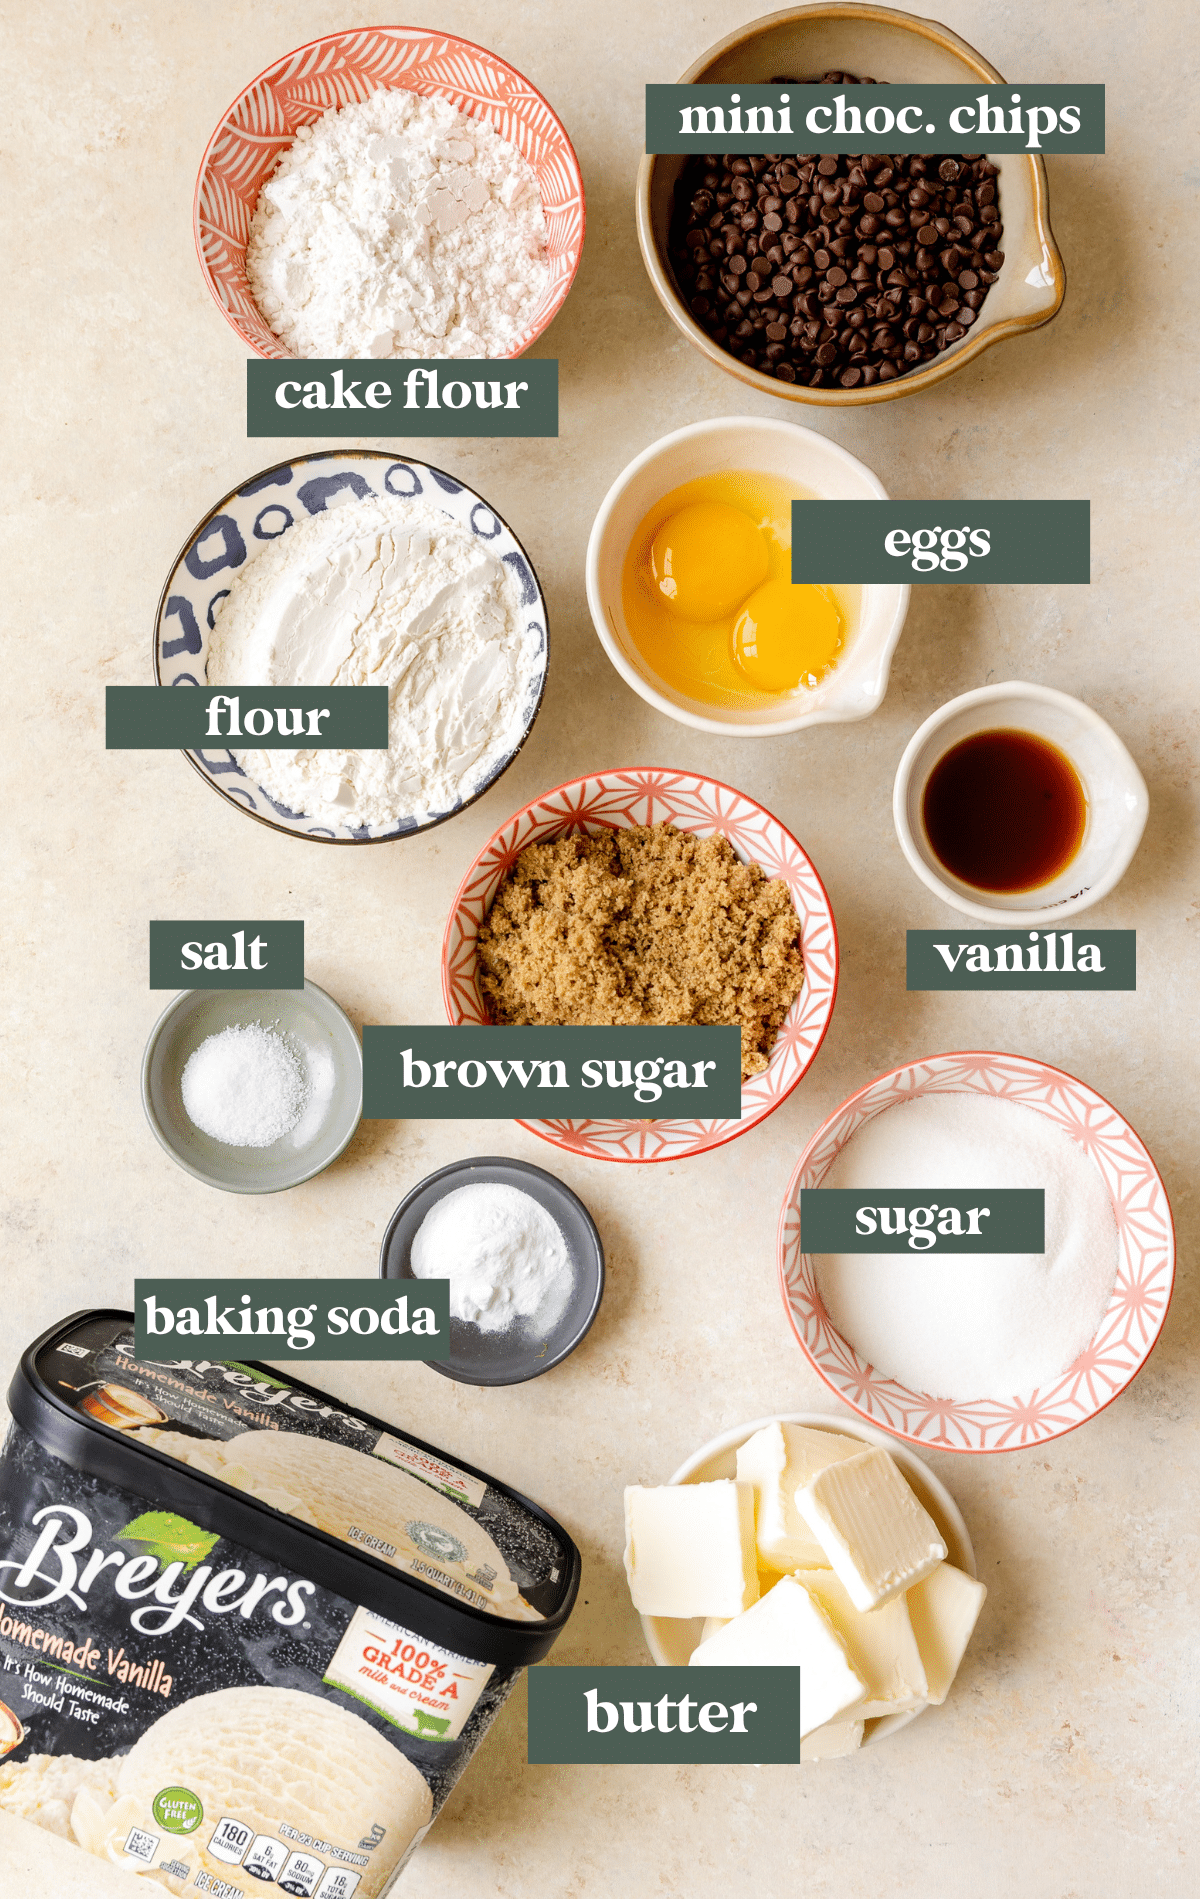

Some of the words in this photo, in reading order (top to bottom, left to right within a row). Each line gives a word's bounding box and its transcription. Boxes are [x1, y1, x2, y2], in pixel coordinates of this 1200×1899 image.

[116, 1355, 217, 1404] Homemade
[223, 1398, 280, 1432] Vanilla
[154, 1385, 180, 1400] How
[183, 1397, 248, 1429] Homemade
[347, 1526, 364, 1543] ICE
[364, 1534, 397, 1558] CREAM
[0, 1505, 316, 1636] Breyers
[410, 1558, 426, 1574] 1.5
[426, 1565, 455, 1590] QUART
[107, 1647, 173, 1698] Vanilla
[362, 1646, 438, 1692] GRADE
[438, 1681, 459, 1700] A
[390, 1638, 448, 1679] 100%
[3, 1654, 21, 1675] It's
[24, 1663, 52, 1686] How
[55, 1675, 130, 1714] Homemade
[21, 1683, 66, 1713] Should
[69, 1700, 100, 1724] Taste
[358, 1665, 389, 1686] milk
[389, 1683, 407, 1695] and
[408, 1690, 450, 1711] cream
[159, 1796, 196, 1811] GLUTEN
[164, 1808, 187, 1820] FREE
[213, 1836, 244, 1856] CALORIES
[219, 1823, 248, 1846] 180
[279, 1823, 299, 1841] PER
[312, 1838, 332, 1854] CUP
[330, 1847, 370, 1867] SERVING
[252, 1853, 265, 1863] SAT
[266, 1858, 278, 1869] FAT
[287, 1869, 313, 1885] SODIUM
[194, 1869, 214, 1891] ICE
[210, 1879, 244, 1899] CREAM
